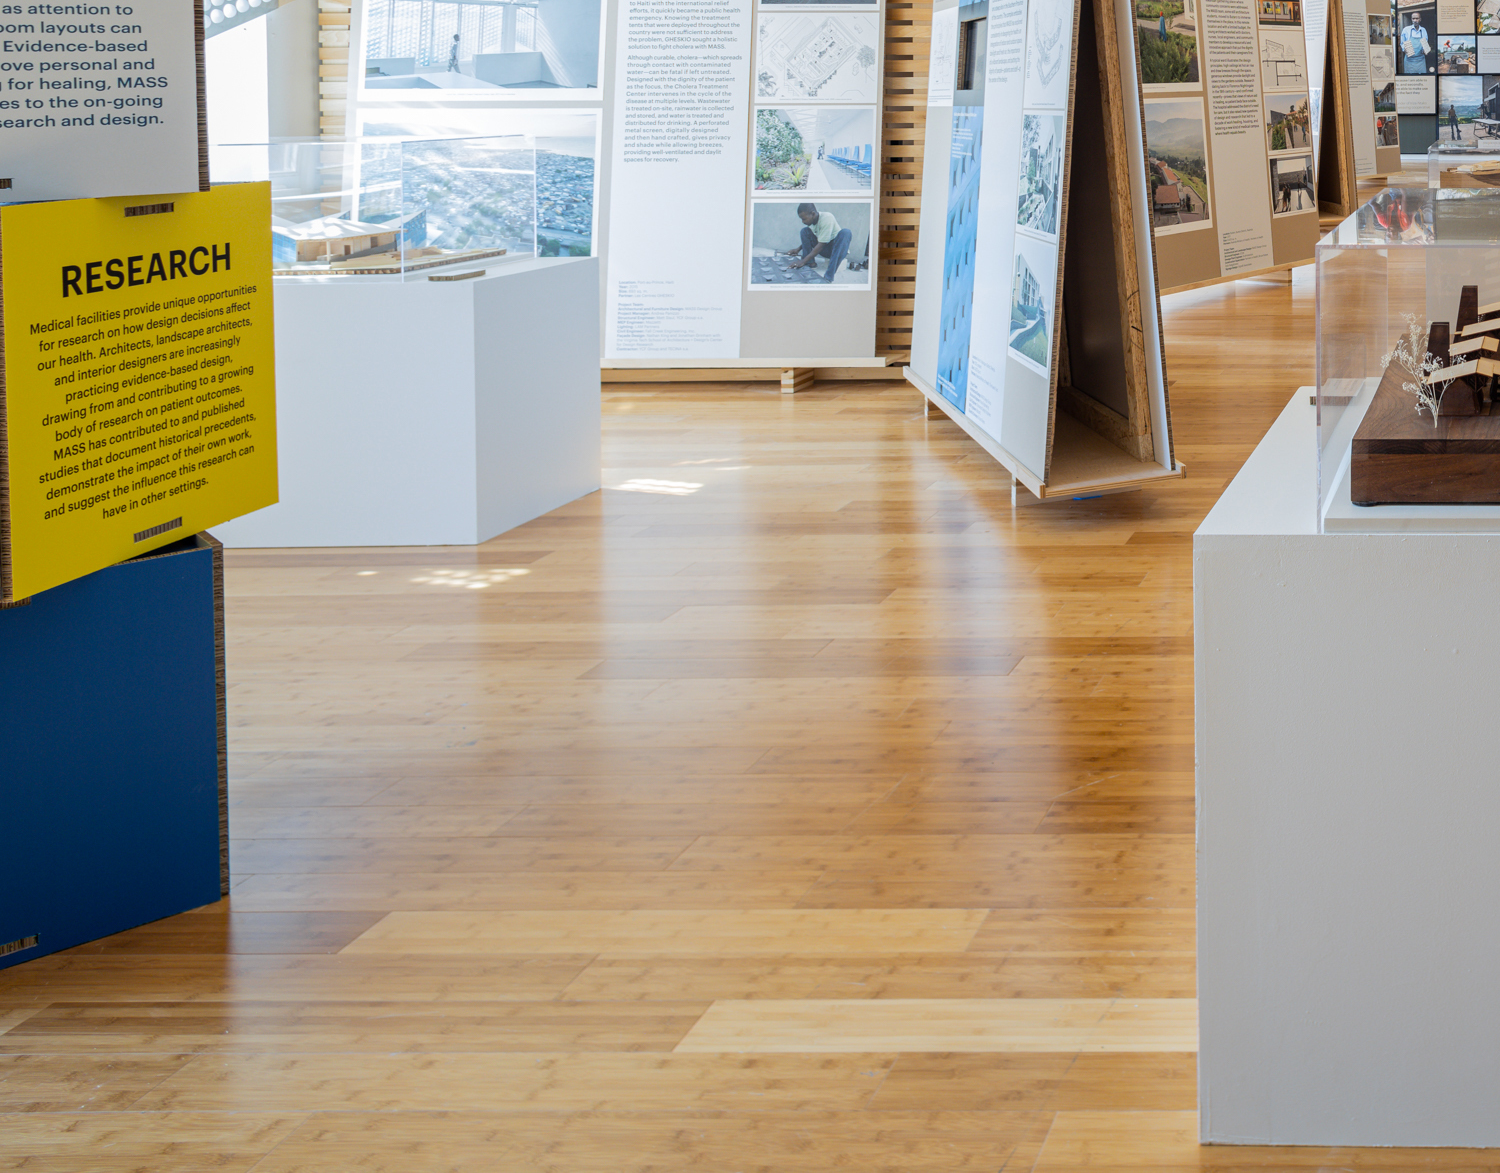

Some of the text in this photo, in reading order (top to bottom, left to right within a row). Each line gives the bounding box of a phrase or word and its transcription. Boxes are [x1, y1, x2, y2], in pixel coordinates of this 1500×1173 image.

[40, 20, 106, 36] layouts
[110, 24, 142, 34] can
[3, 39, 148, 53] Evidence-based
[39, 58, 118, 74] personal
[122, 57, 155, 71] and
[7, 76, 169, 92] for healing, MASS
[24, 98, 44, 109] to
[48, 95, 79, 109] the
[83, 94, 163, 110] on-going
[61, 113, 95, 127] and
[99, 112, 164, 128] design.
[29, 284, 257, 336] Medical facilities provide unique opportunities
[38, 301, 251, 353] for research on how design decisions affect
[37, 318, 253, 372] our health. Architects, landscape architects,
[102, 504, 128, 520] have
[140, 490, 168, 506] other
[168, 477, 209, 497] settings.
